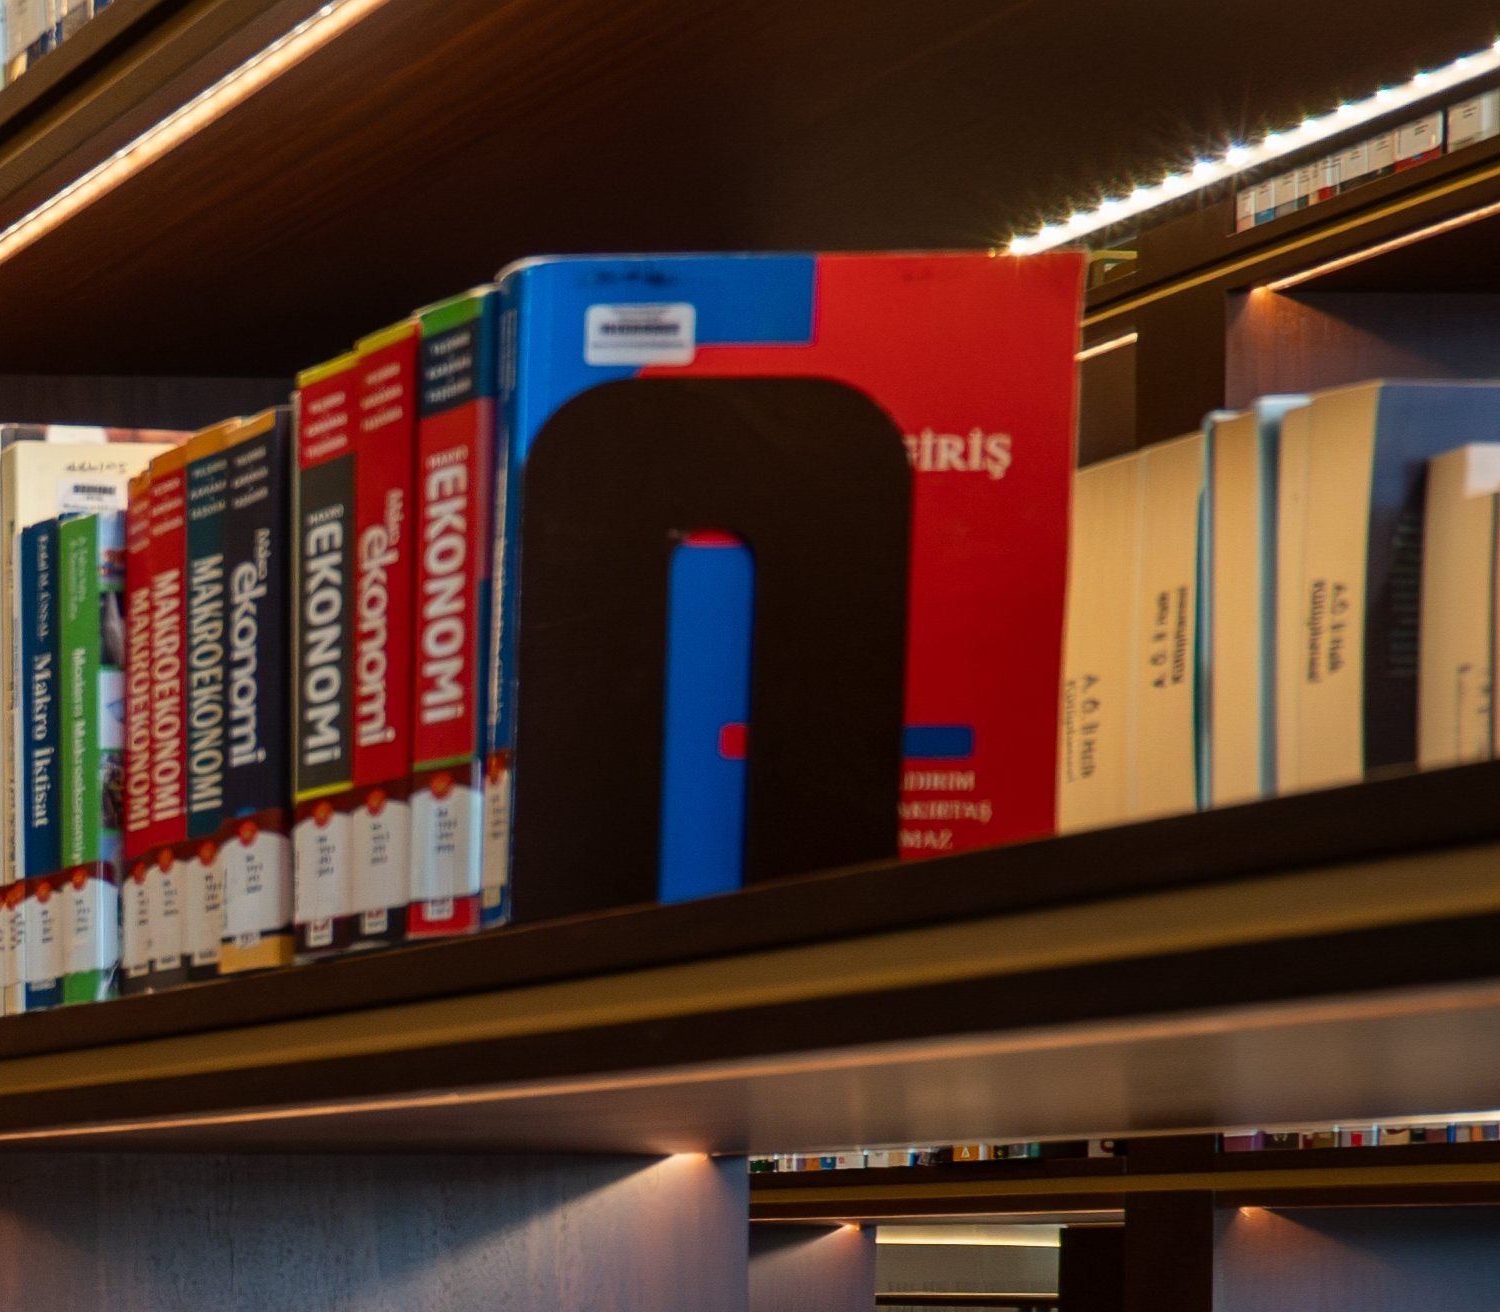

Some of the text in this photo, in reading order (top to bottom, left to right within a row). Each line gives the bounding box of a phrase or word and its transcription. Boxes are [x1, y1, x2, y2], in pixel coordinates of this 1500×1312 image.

[74, 648, 87, 715] Modern
[150, 568, 186, 822] MAKROEKONOMİ
[229, 561, 268, 768] ekonomi
[302, 518, 345, 771] EKONOMİ
[355, 524, 399, 747] ekonomi
[420, 463, 468, 726] EKONOMİ
[31, 653, 55, 828] Makro İktisat
